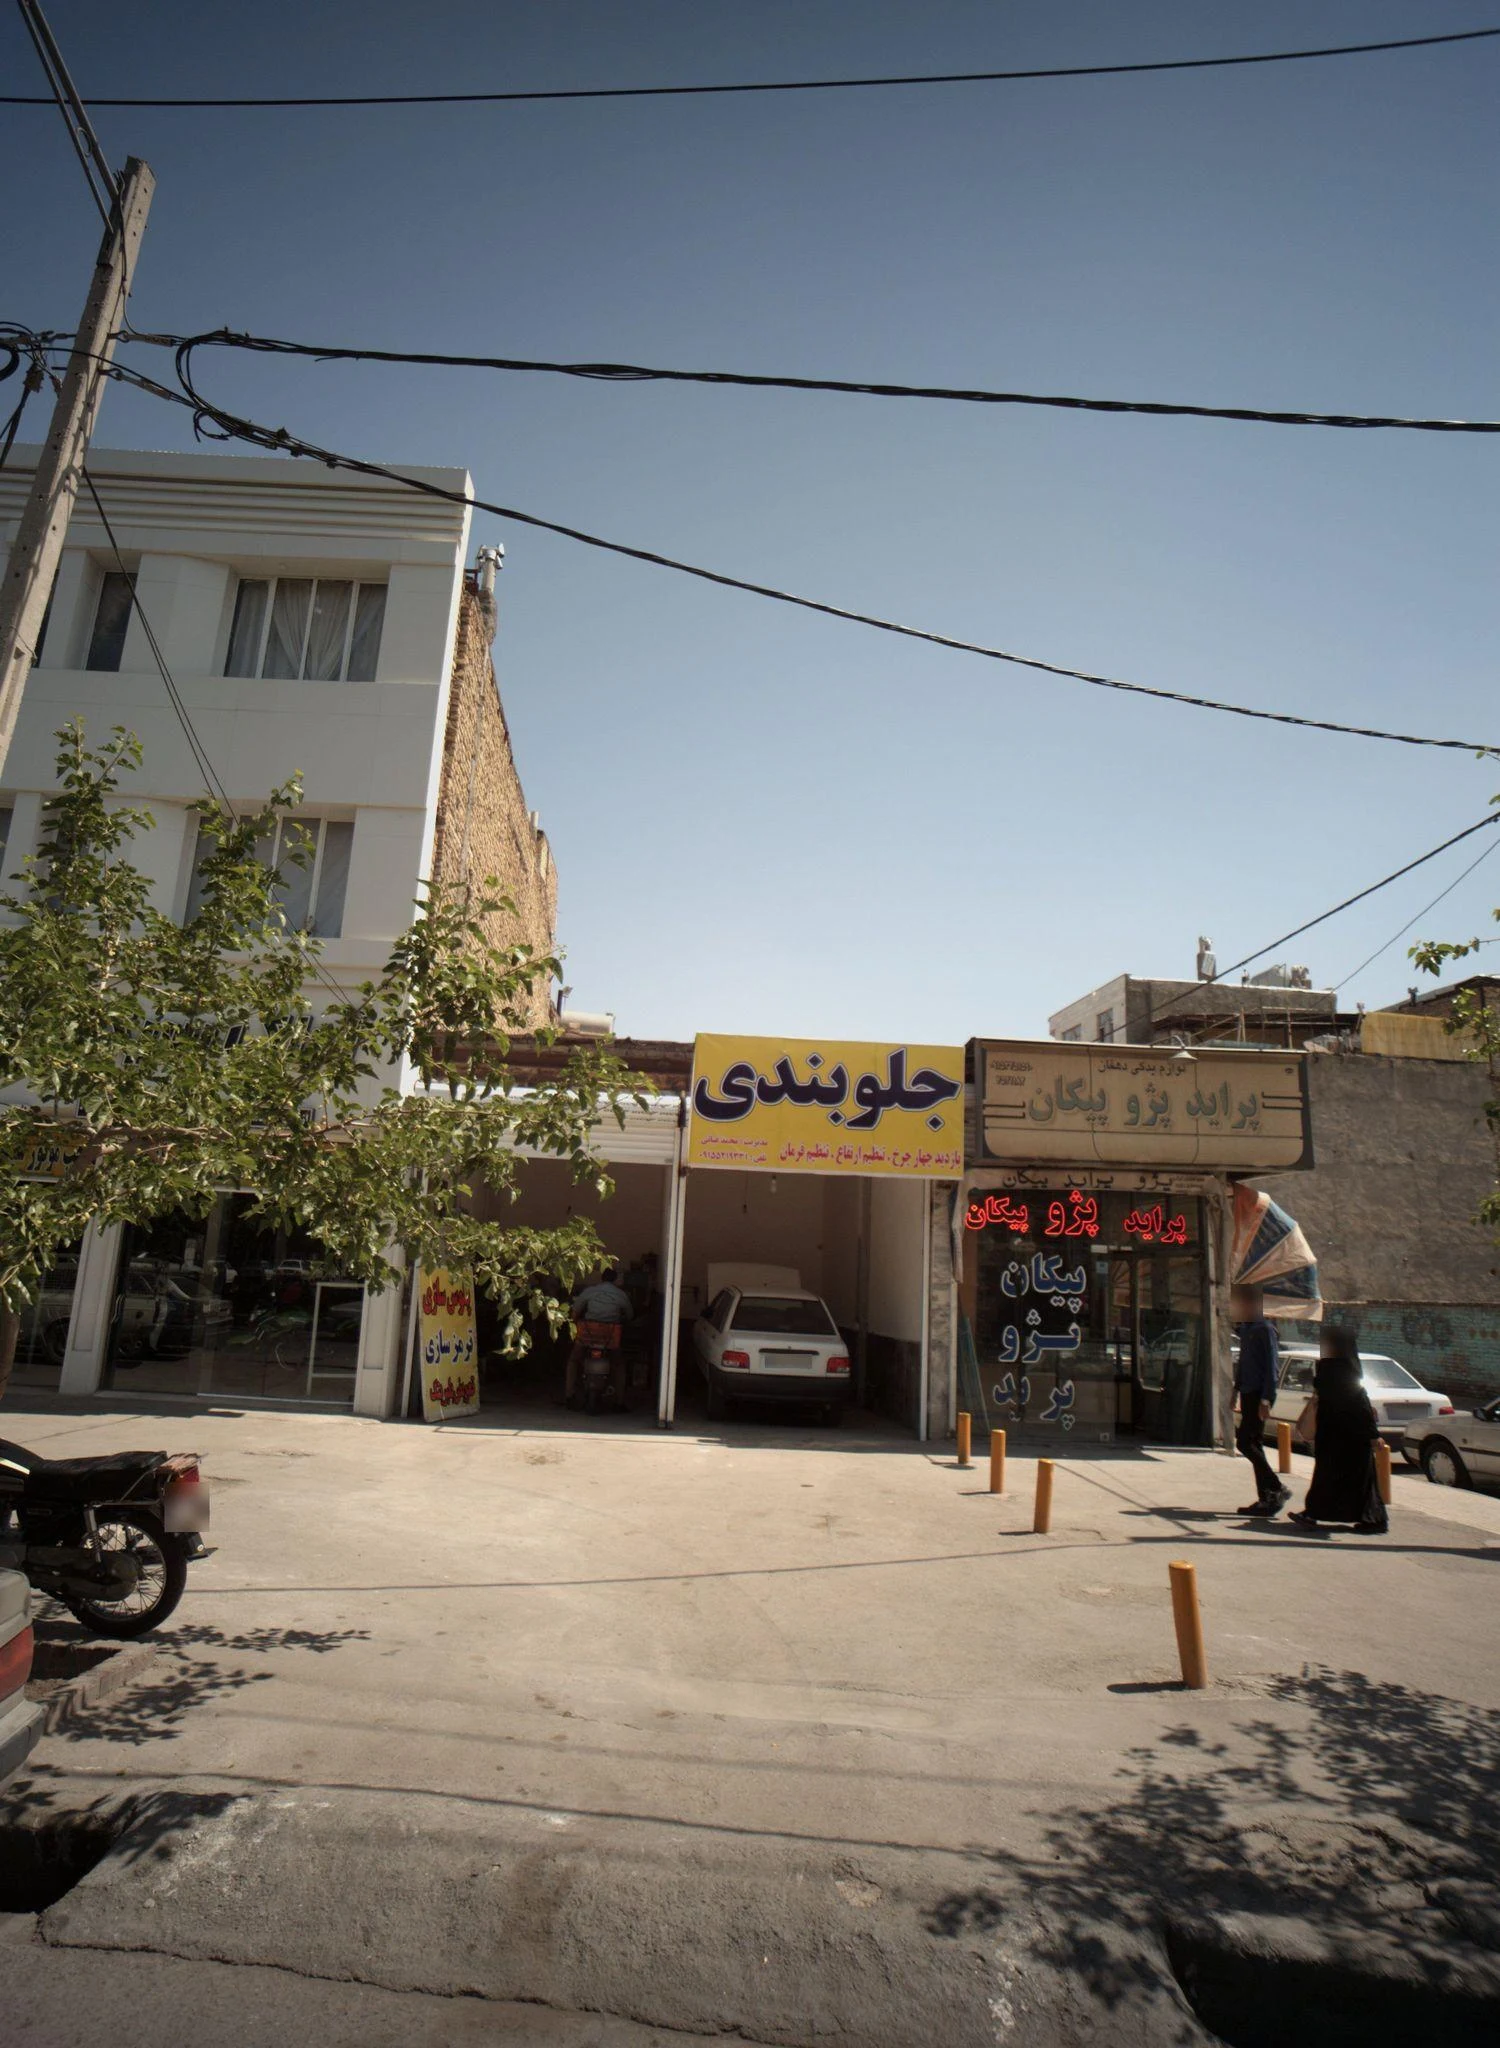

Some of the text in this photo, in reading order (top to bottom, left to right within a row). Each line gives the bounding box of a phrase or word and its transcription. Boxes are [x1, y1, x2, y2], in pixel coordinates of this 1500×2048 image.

[694, 1046, 963, 1132] جلوبندی
[1028, 1074, 1262, 1131] پراید پژو پیکان
[1002, 1168, 1049, 1188] پیکان
[1064, 1170, 1114, 1189] پراید
[964, 1189, 1188, 1244] پراید پژو پیکان
[1001, 1252, 1087, 1312] پیکان
[425, 1328, 474, 1365] ترمز سازی
